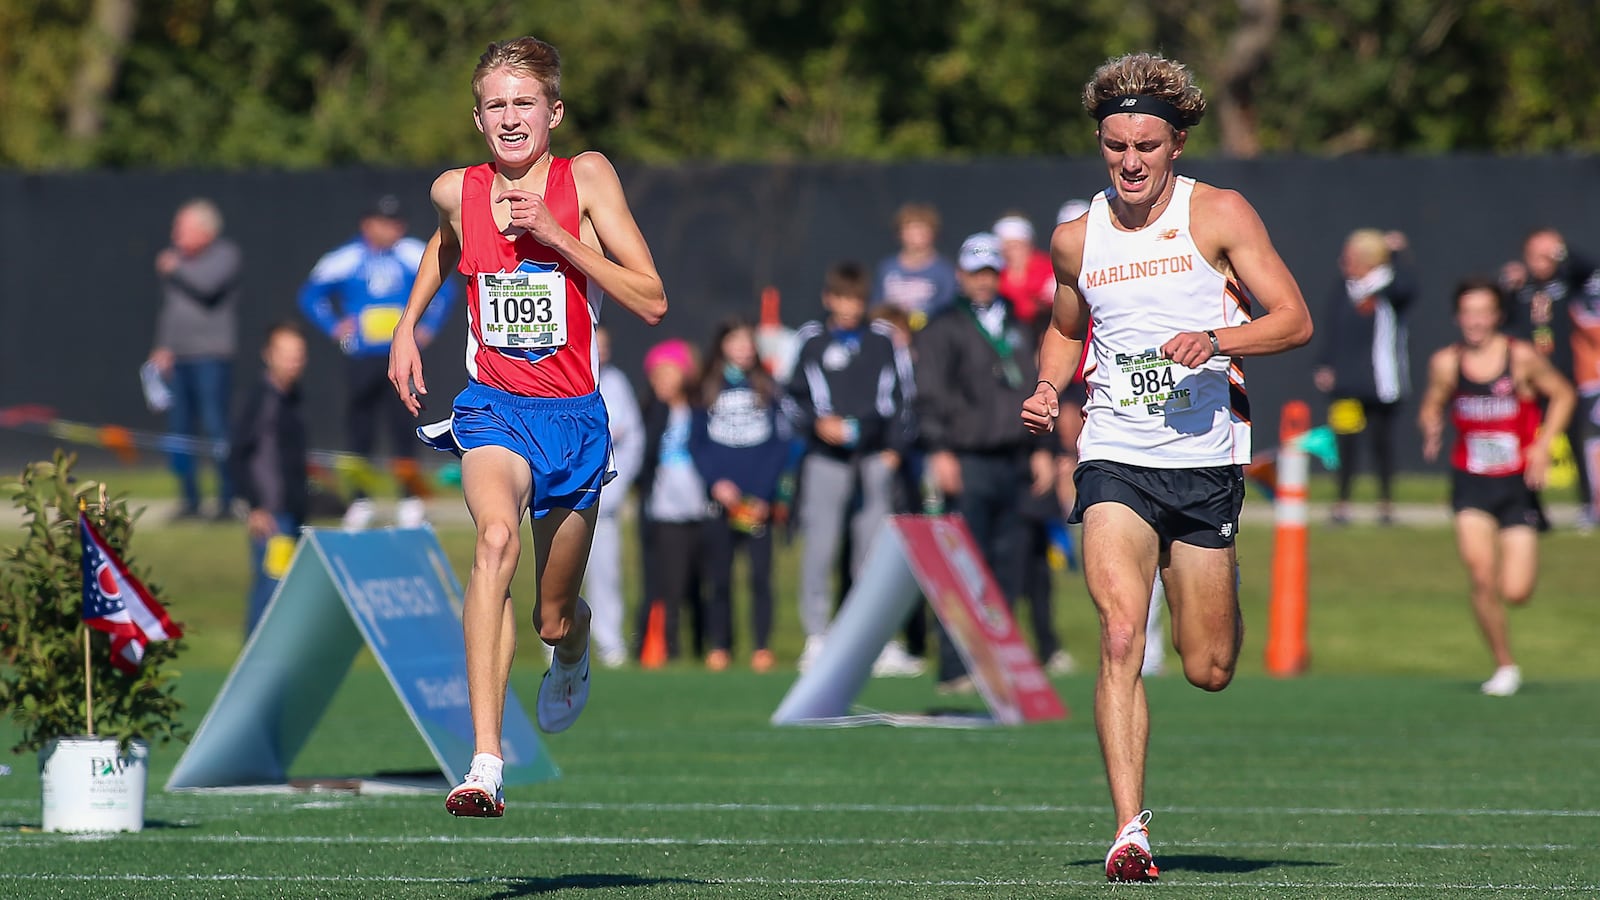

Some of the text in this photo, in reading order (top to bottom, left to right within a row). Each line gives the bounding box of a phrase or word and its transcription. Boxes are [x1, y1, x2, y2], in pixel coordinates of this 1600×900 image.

[1120, 98, 1137, 107] NB
[1086, 255, 1193, 289] MARLINGTON
[489, 297, 553, 324] 1093
[486, 323, 558, 333] M-F ATHLETIC
[1130, 366, 1176, 396] 984
[1120, 388, 1191, 408] M-F ATHLETIC
